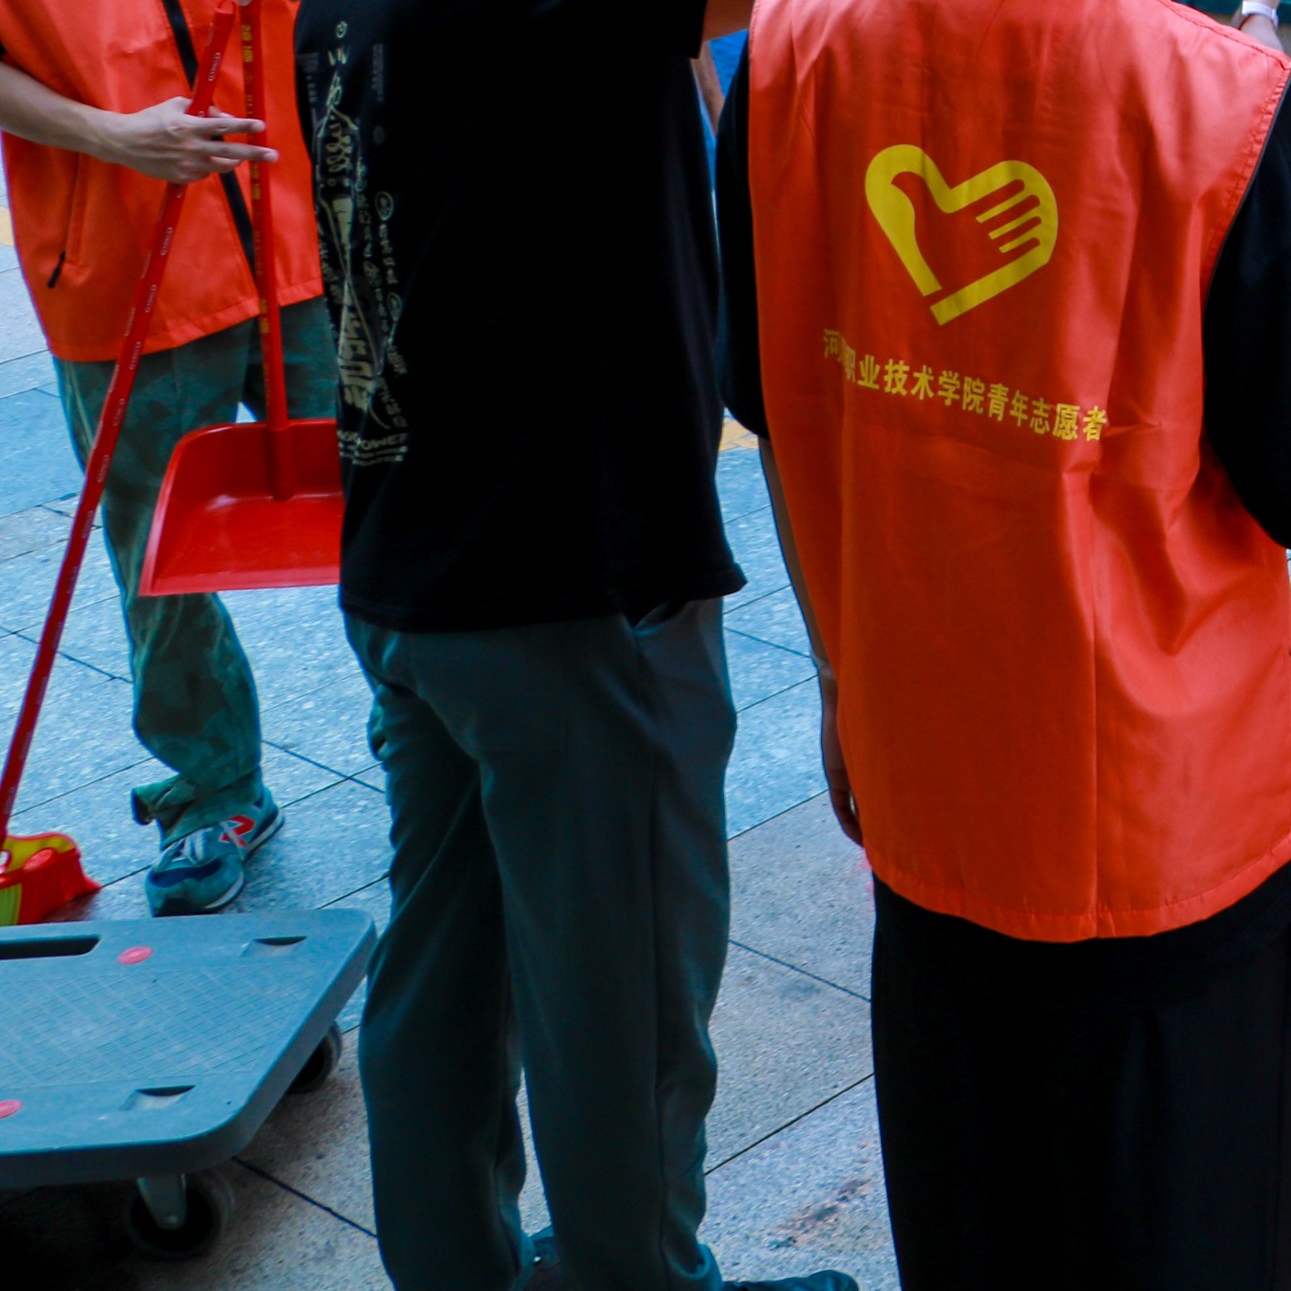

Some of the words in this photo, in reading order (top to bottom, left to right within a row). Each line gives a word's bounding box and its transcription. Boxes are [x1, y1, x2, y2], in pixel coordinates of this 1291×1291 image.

[823, 327, 1110, 442] 河职业技术学院青年志愿者
